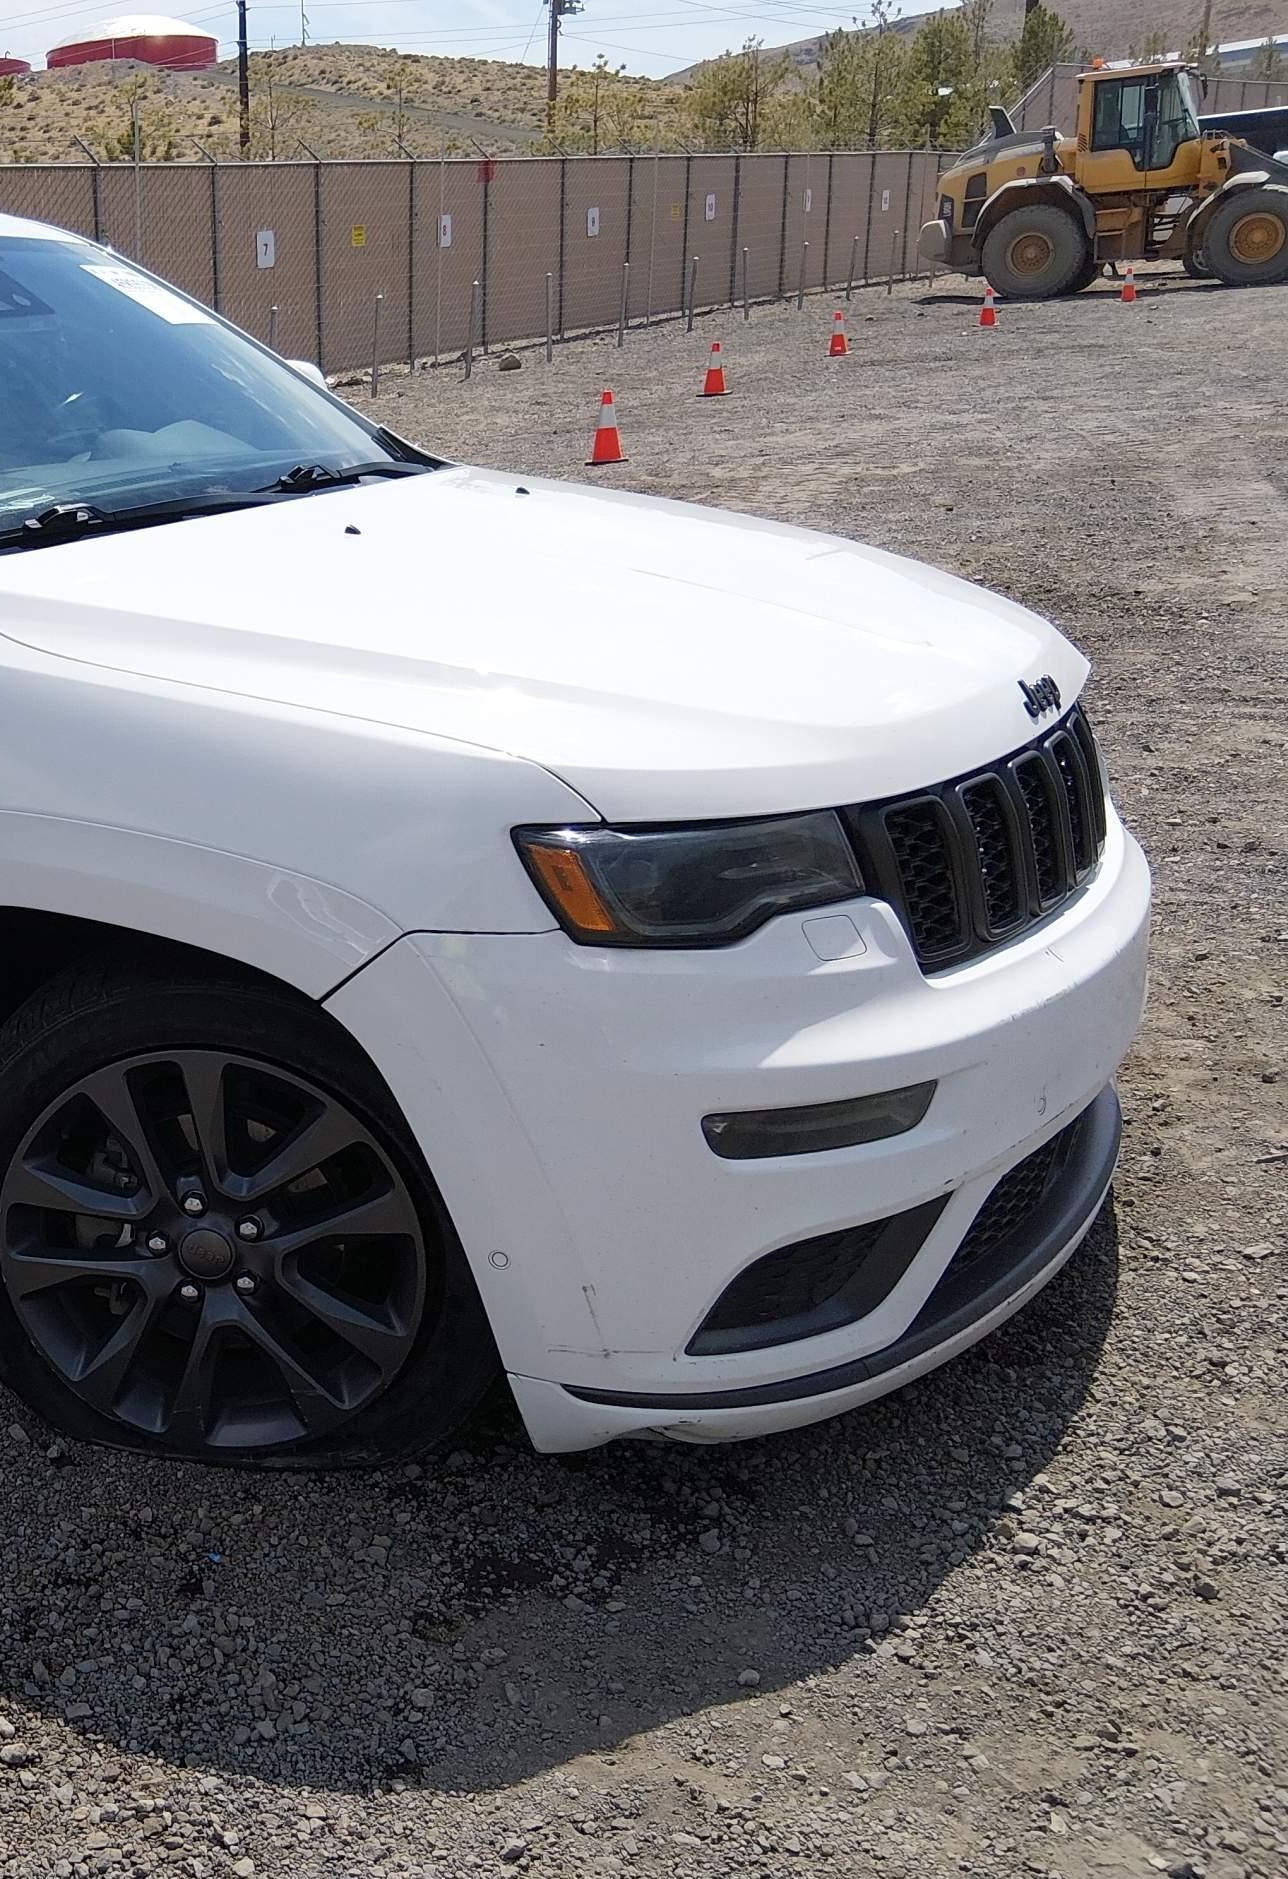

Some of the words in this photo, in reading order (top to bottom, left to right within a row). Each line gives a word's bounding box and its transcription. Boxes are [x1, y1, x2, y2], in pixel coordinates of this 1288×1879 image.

[442, 225, 447, 236] 8
[263, 243, 268, 256] 7
[1017, 674, 1061, 718] Jeep
